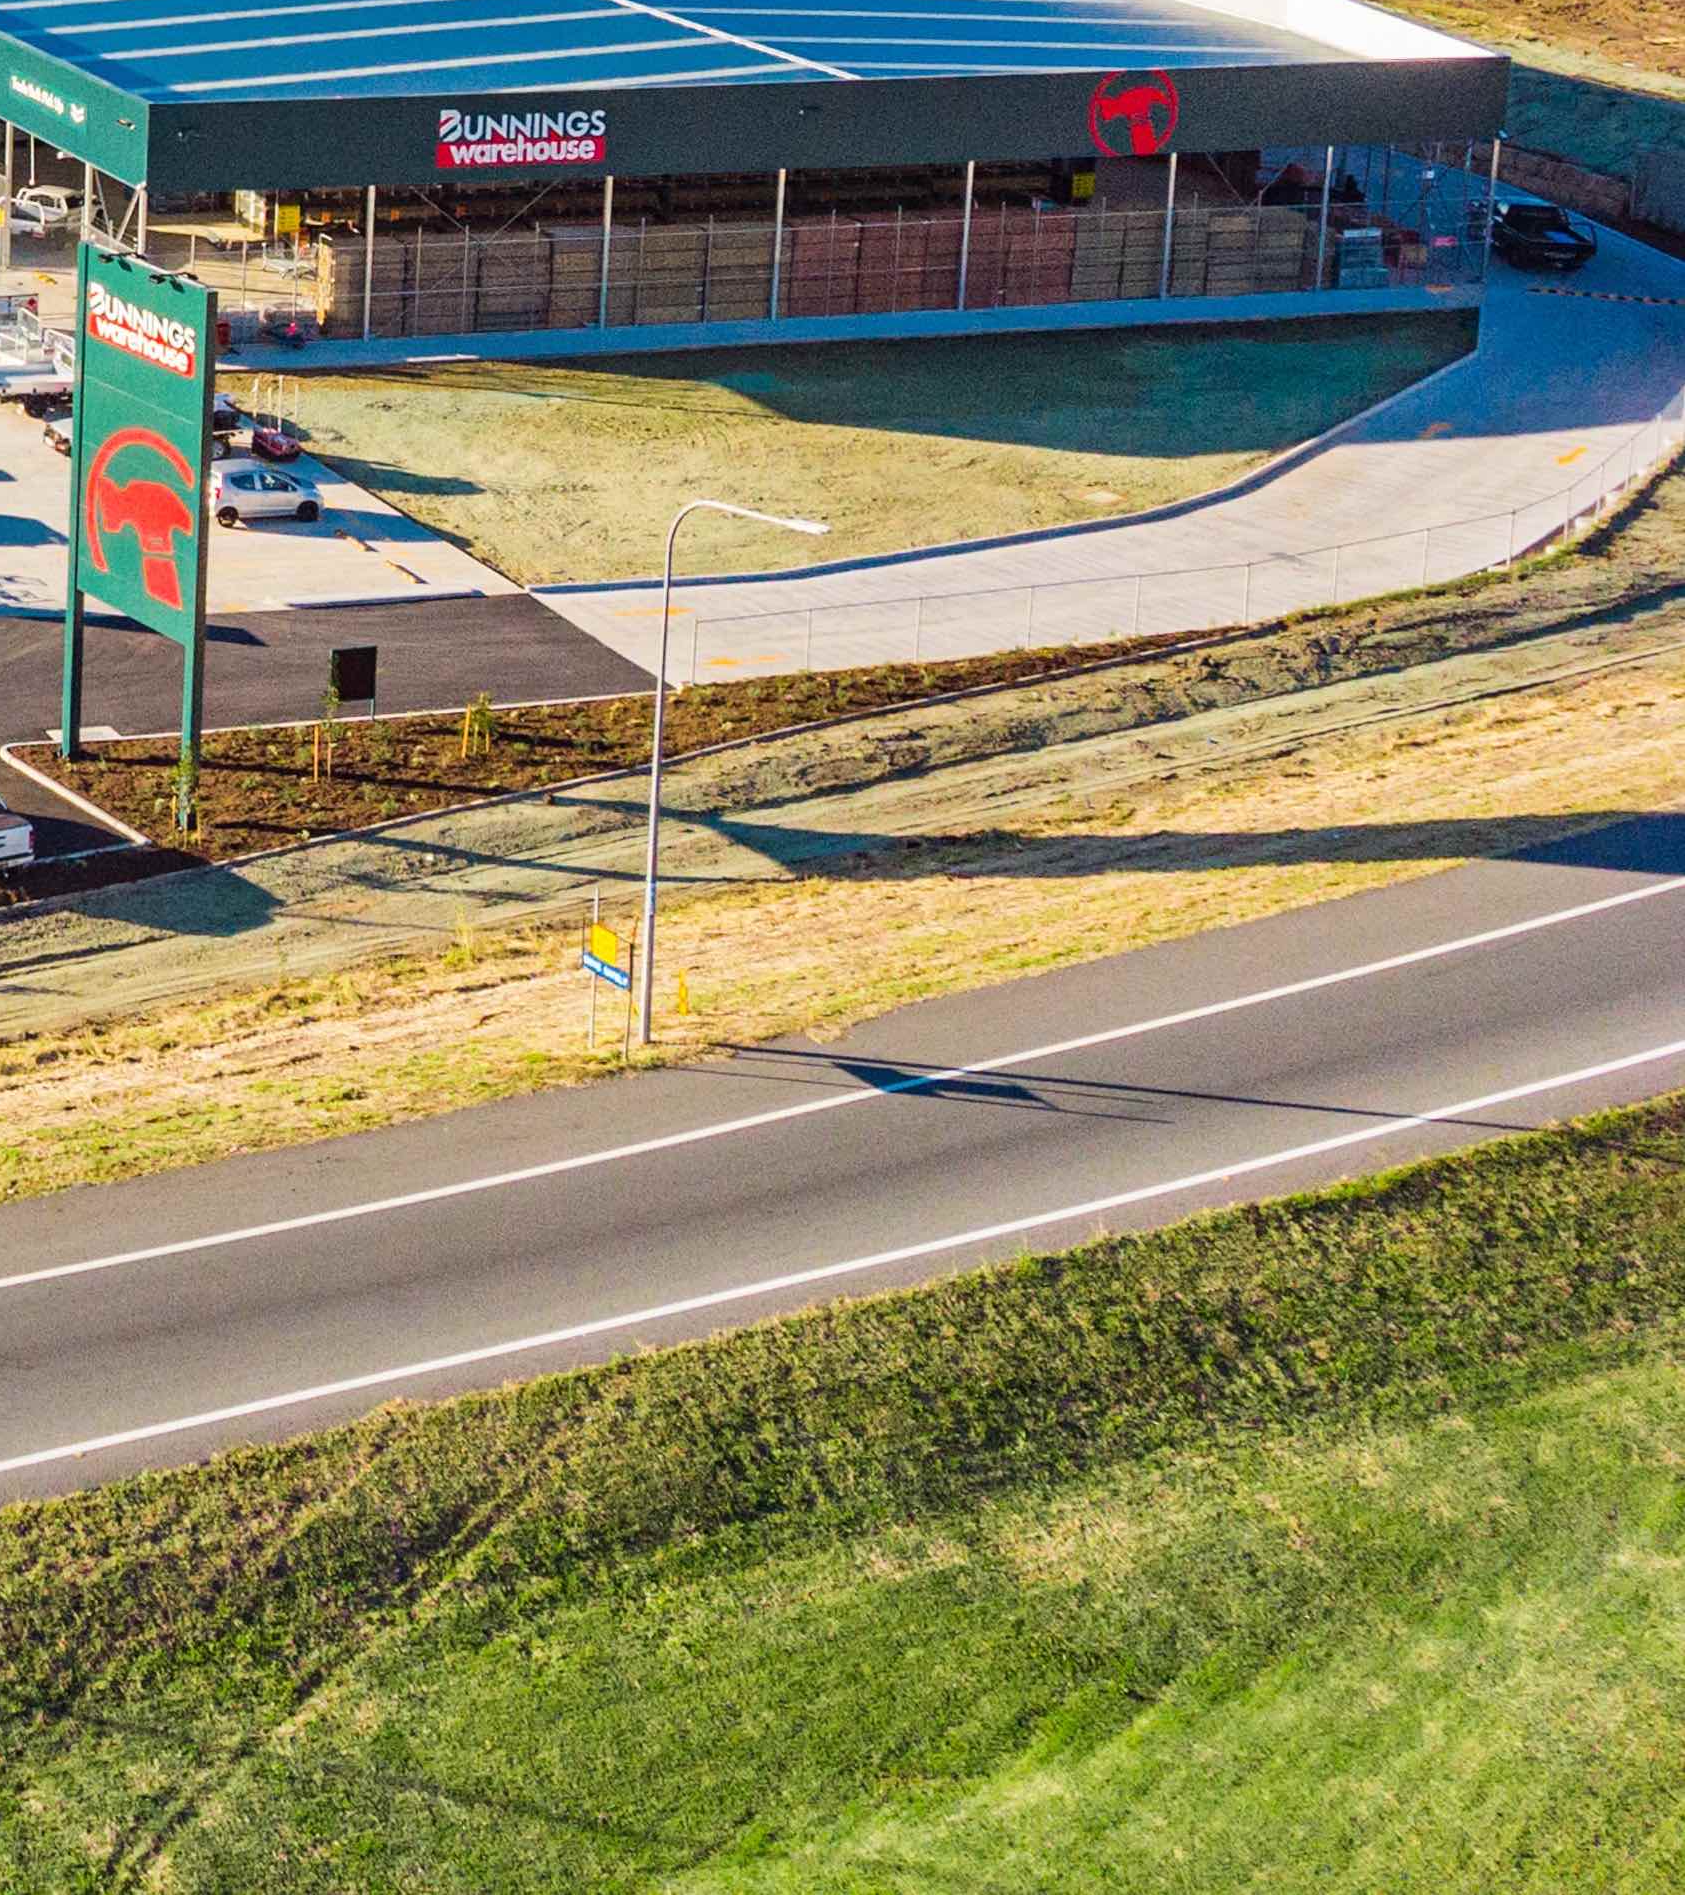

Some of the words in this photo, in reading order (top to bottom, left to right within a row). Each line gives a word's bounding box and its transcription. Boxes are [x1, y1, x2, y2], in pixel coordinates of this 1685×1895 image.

[439, 109, 606, 142] BUNNINGS
[449, 134, 596, 165] warehouse
[88, 281, 196, 354] BUNNINGS
[95, 316, 189, 373] warehouse
